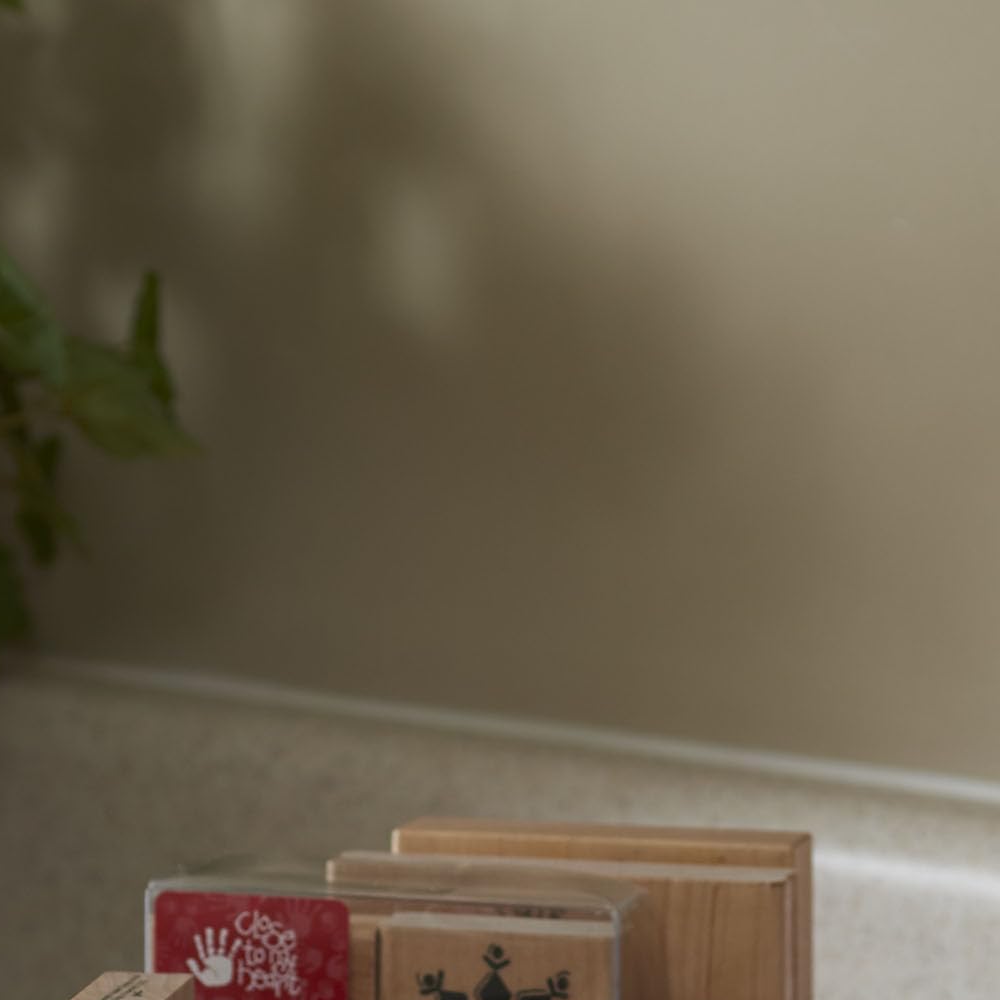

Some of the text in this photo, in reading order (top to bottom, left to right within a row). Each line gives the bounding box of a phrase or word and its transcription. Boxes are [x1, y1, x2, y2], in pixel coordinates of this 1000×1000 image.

[234, 910, 297, 950] Close
[244, 940, 266, 966] to
[237, 960, 302, 998] heart
